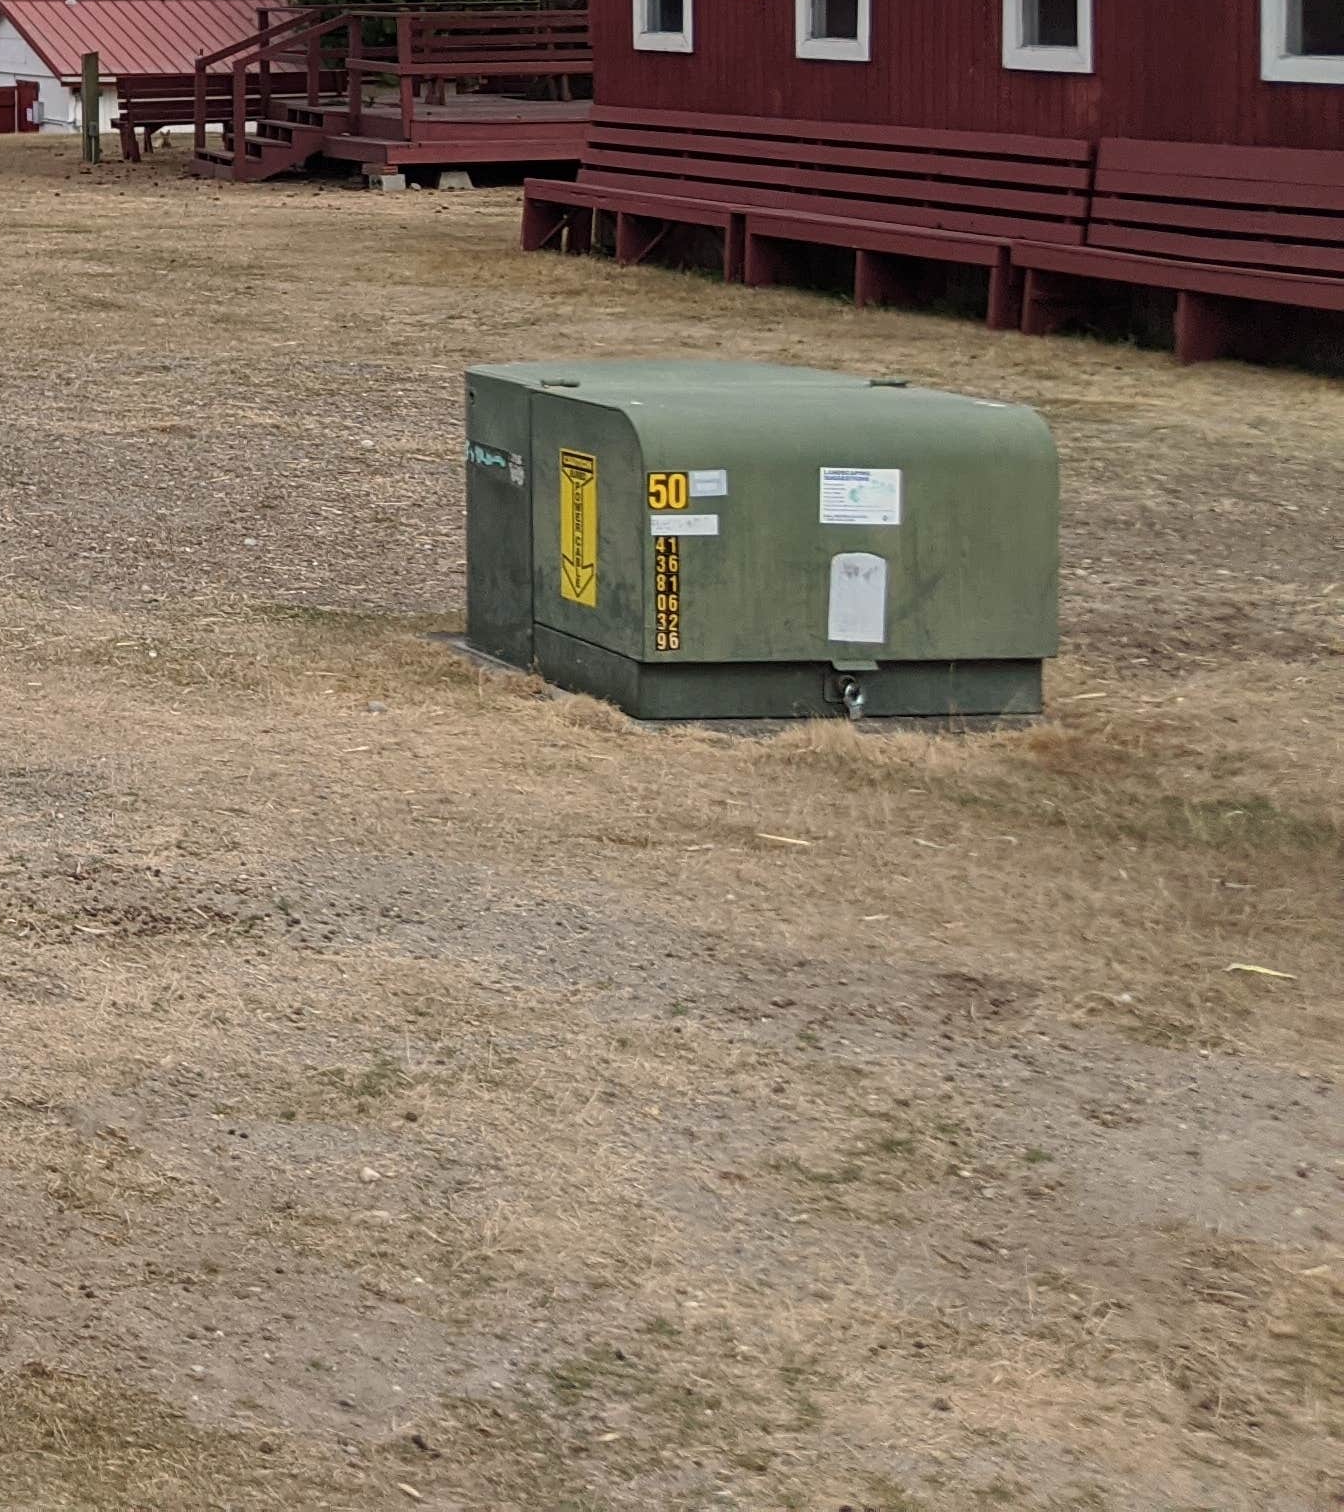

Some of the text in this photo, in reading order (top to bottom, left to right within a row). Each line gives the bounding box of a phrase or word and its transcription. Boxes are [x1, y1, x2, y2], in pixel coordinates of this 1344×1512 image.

[648, 473, 687, 509] 50
[656, 536, 677, 553] 41
[656, 554, 678, 573] 36
[656, 573, 677, 592] 81
[657, 593, 678, 612] 06
[657, 613, 678, 631] 32
[657, 632, 679, 650] 96
